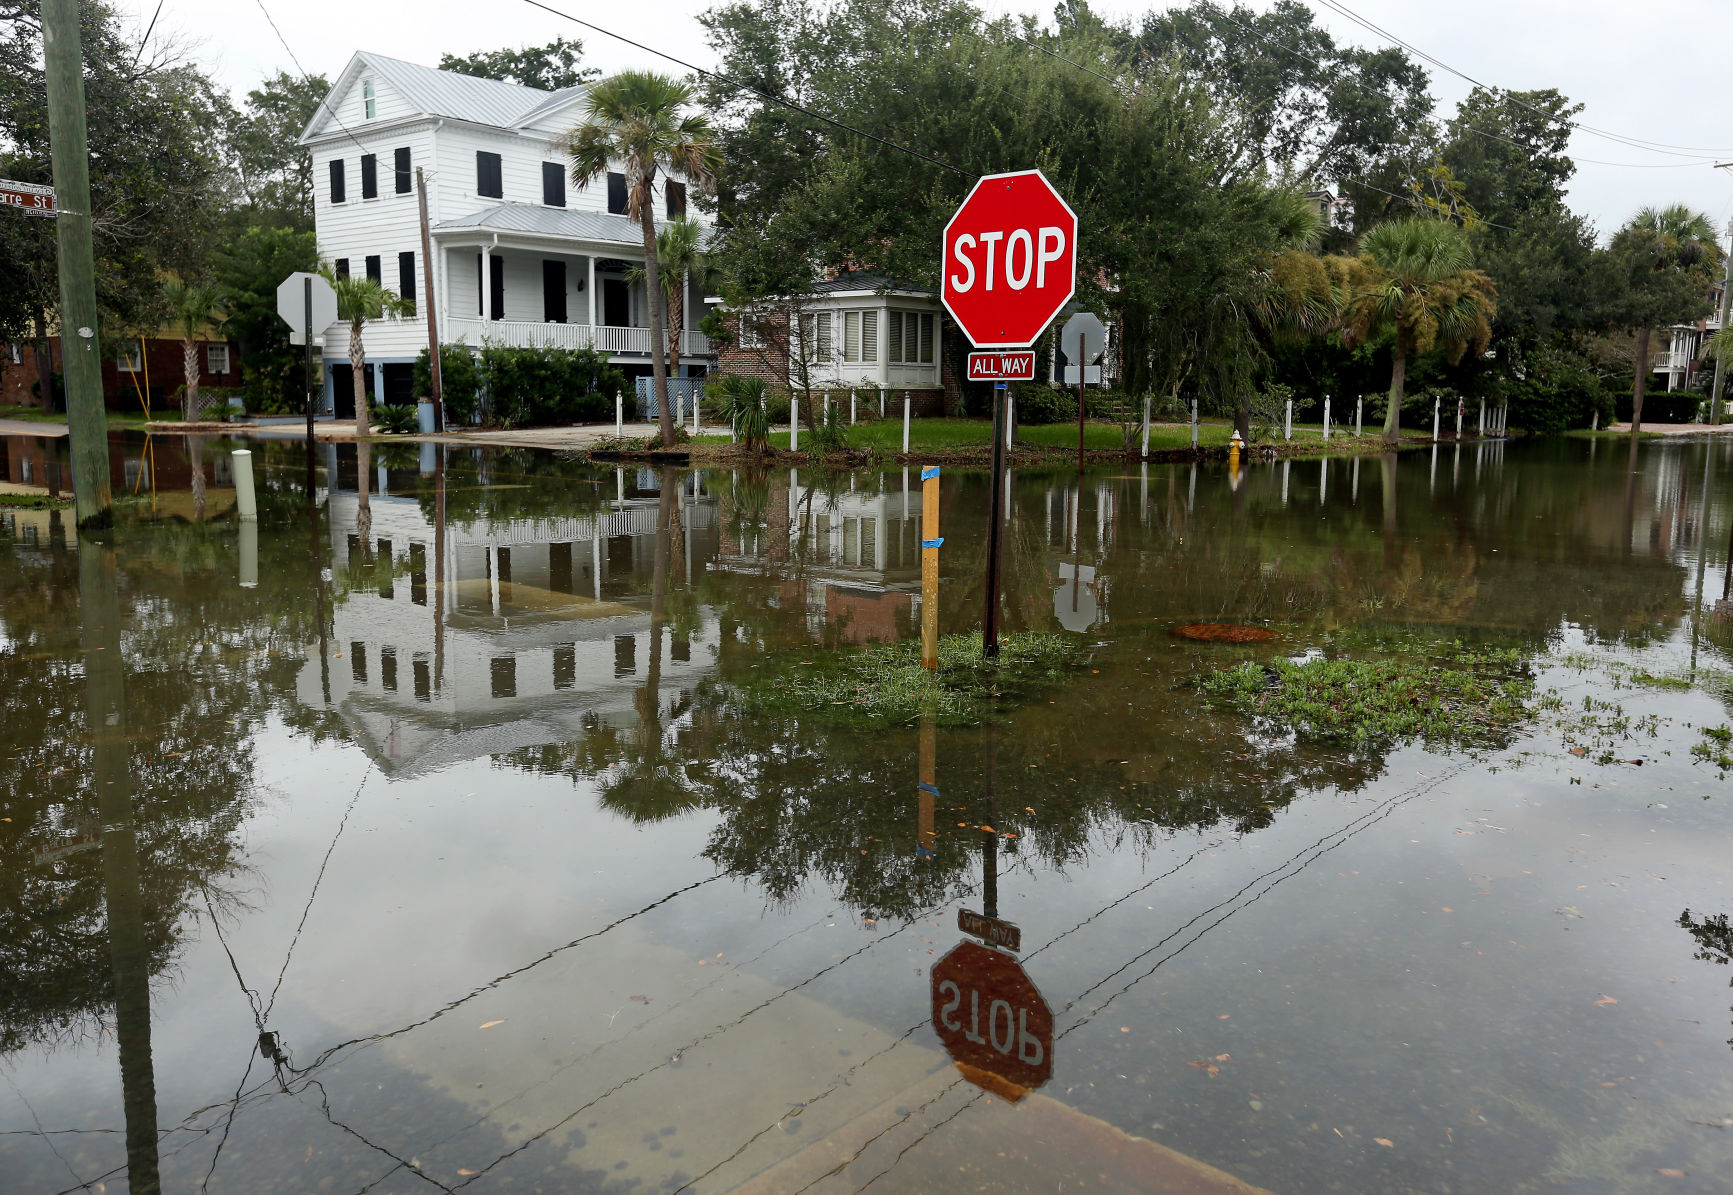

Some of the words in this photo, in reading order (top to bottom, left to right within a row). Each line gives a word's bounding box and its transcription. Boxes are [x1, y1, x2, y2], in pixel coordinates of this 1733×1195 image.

[33, 195, 47, 209] St
[951, 226, 1065, 293] STOP
[973, 358, 998, 374] ALL
[1001, 357, 1030, 374] WAY
